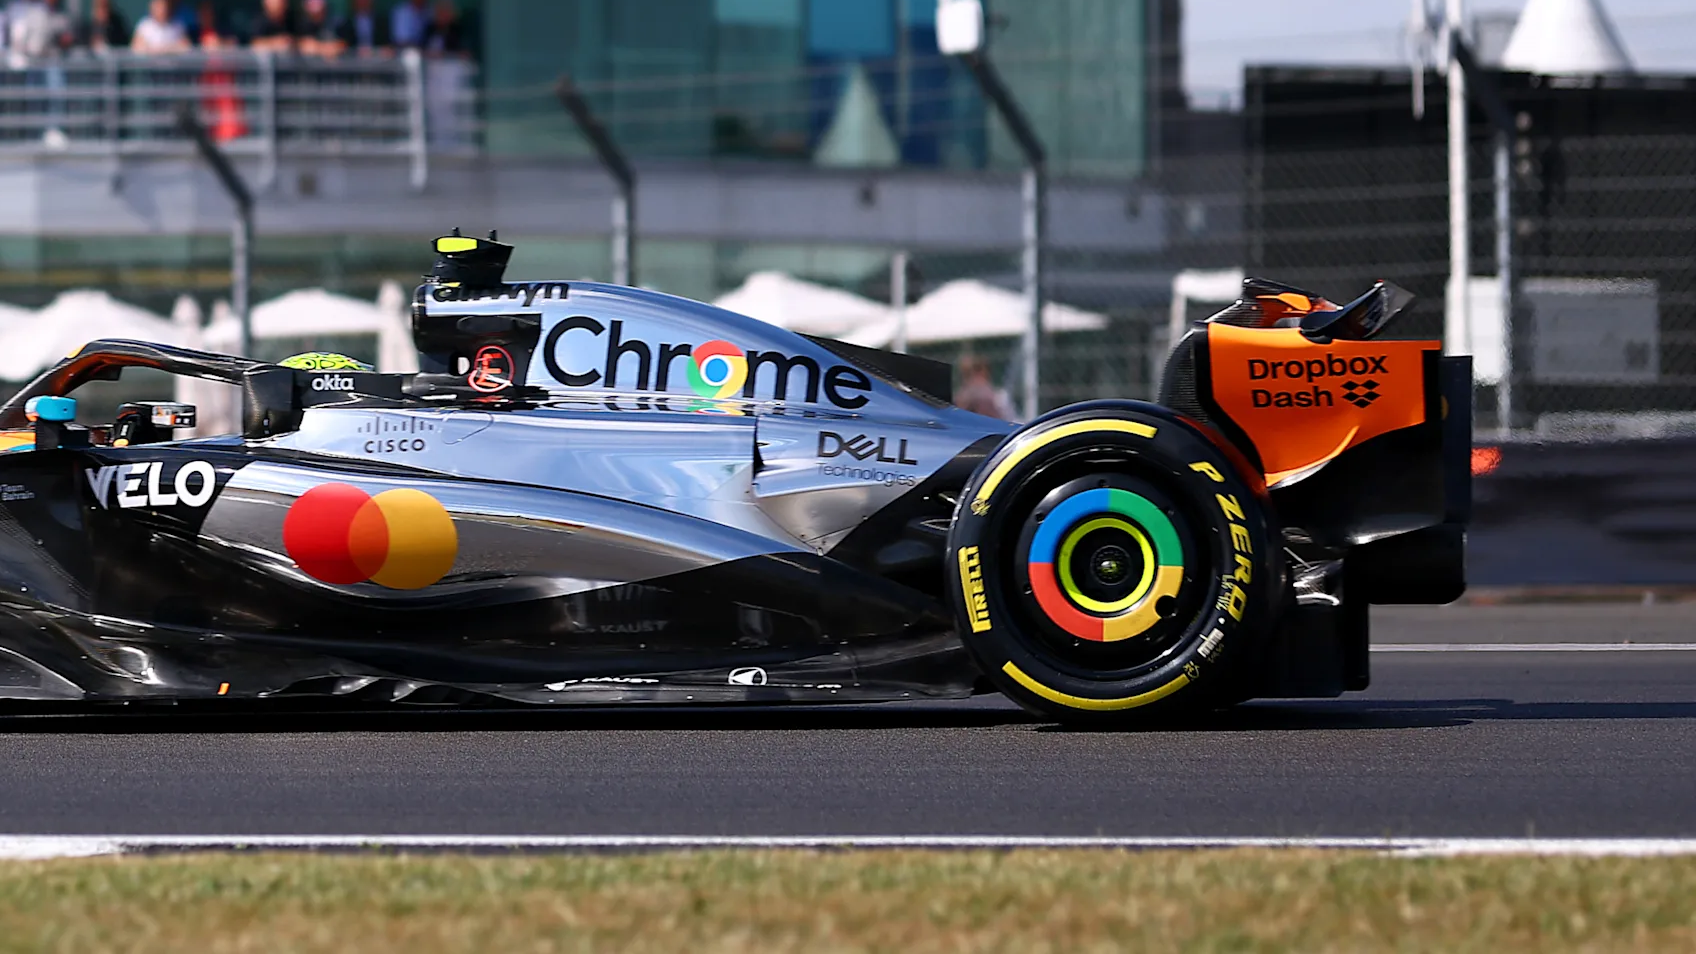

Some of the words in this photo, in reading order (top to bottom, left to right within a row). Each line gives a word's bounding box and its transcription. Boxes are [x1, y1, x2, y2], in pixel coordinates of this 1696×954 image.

[543, 316, 872, 410] Chrome
[1248, 353, 1389, 383] Dropbox
[312, 374, 355, 391] okta
[1252, 386, 1334, 407] Dash
[364, 438, 425, 453] CISCO
[817, 431, 918, 465] DELL
[84, 460, 216, 509] VELO
[816, 462, 916, 487] Technologies
[1188, 461, 1225, 482] P
[1215, 493, 1253, 623] ZERO
[957, 546, 992, 633] PIRELLI
